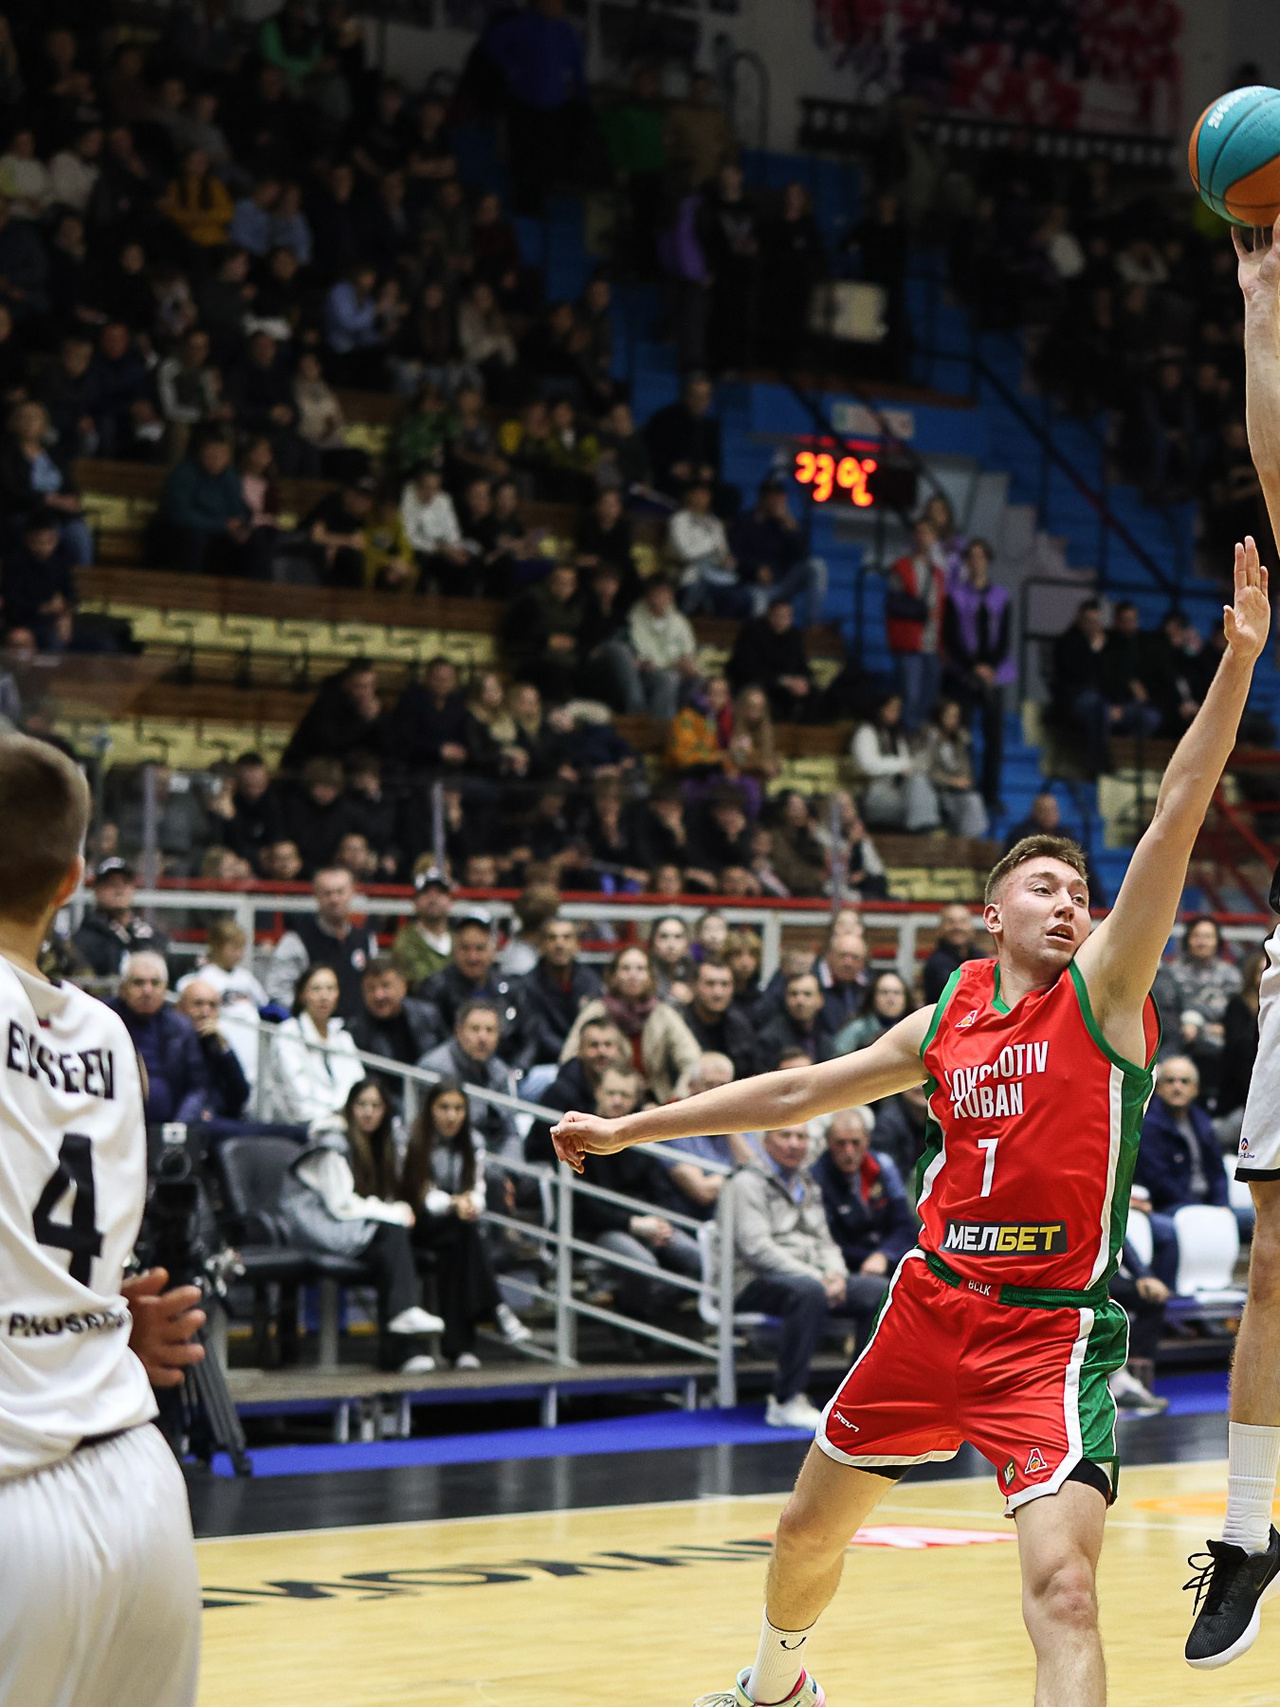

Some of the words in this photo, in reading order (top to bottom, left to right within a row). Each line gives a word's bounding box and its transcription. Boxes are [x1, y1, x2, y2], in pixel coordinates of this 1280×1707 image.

[944, 1040, 1050, 1102] LOKOOTIV
[953, 1082, 1025, 1119] KUBAN
[977, 1137, 1000, 1198] 7
[32, 1132, 104, 1289] 4
[944, 1224, 1062, 1252] МЕЛБЕТ
[967, 1279, 993, 1297] BCLK
